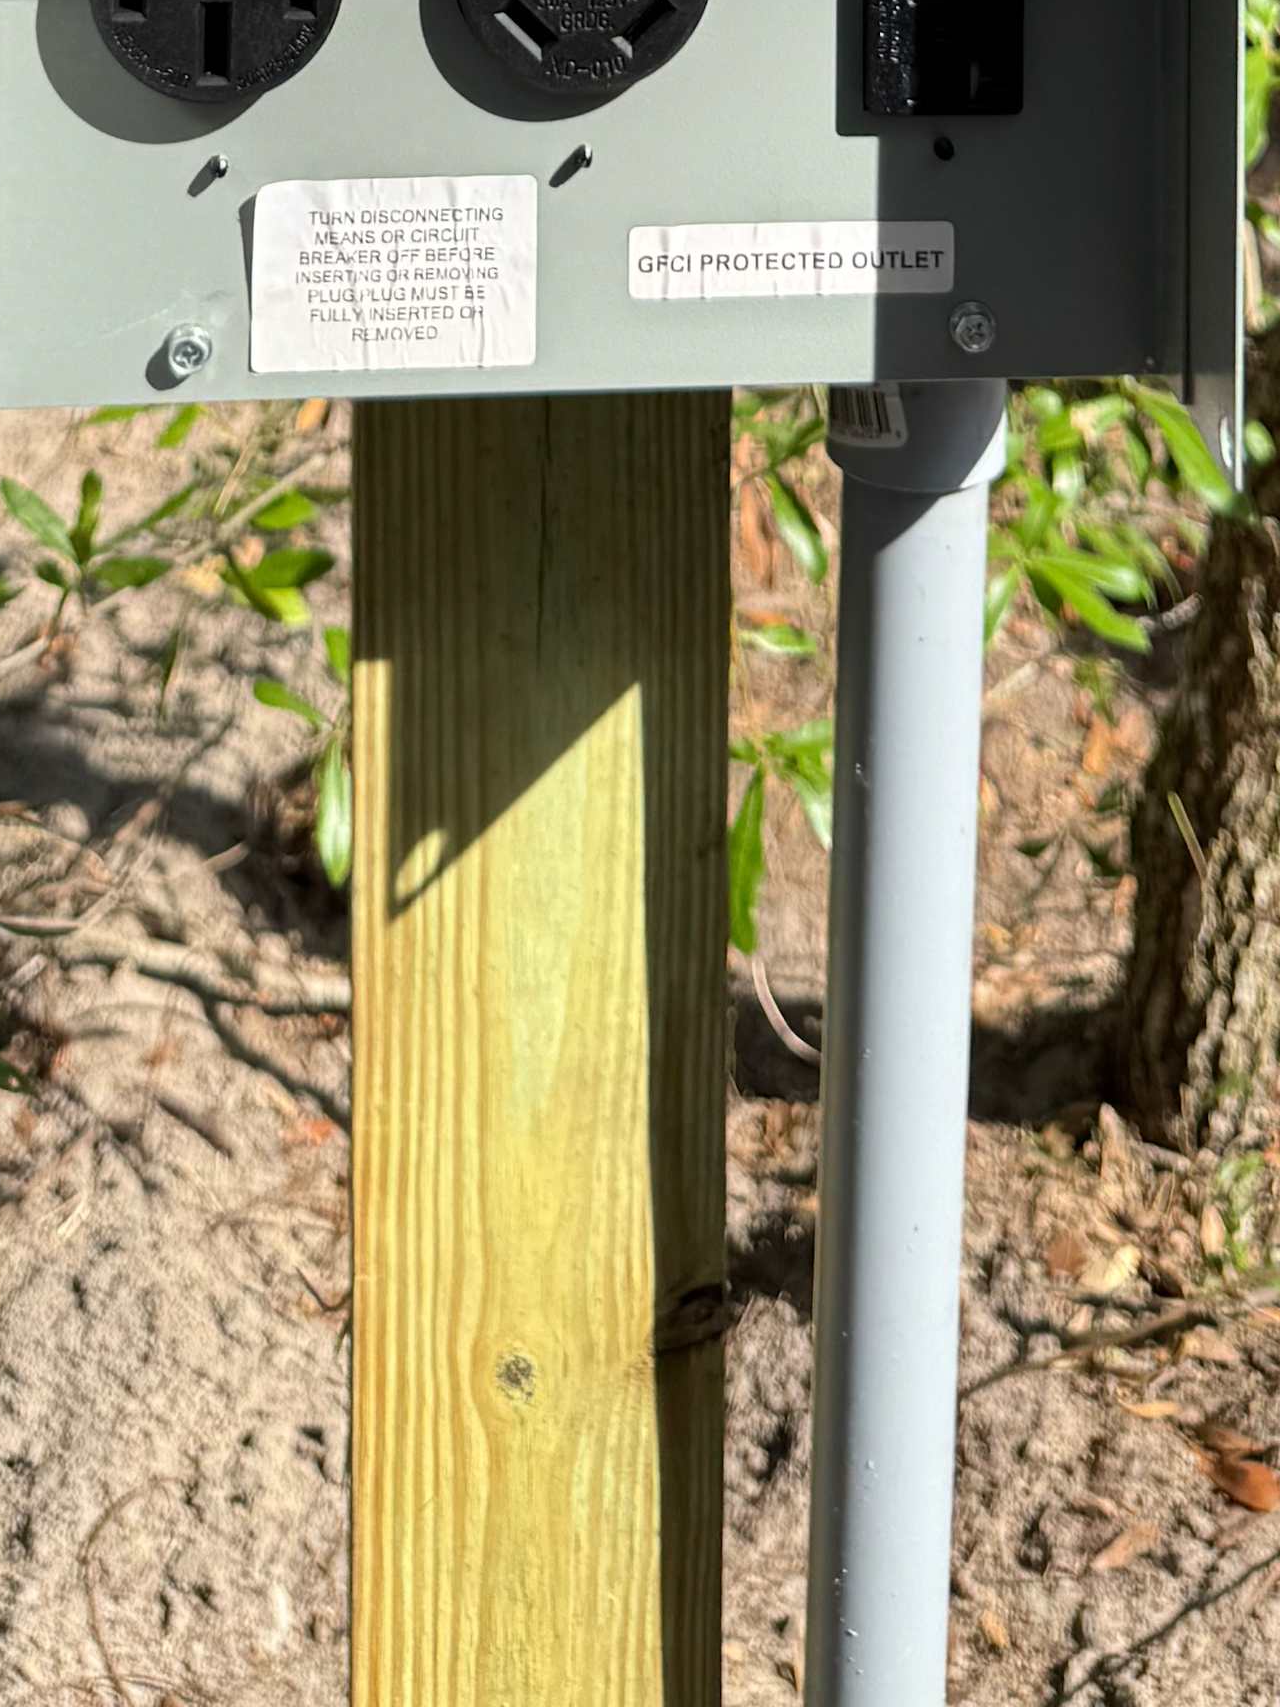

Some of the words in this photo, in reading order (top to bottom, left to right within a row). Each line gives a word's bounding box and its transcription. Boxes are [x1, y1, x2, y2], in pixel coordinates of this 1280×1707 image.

[309, 211, 355, 226] TURN
[360, 208, 504, 225] DISCONNECTING
[315, 230, 375, 246] MEANS
[381, 230, 404, 244] OR
[410, 228, 481, 242] CIRCUIT
[299, 251, 381, 265] BREAKER
[387, 249, 420, 263] OFF
[425, 247, 496, 263] BEFORE
[638, 255, 692, 273] GFCI
[700, 252, 844, 272] PROTECTED
[852, 250, 945, 270] OUTLET
[295, 270, 381, 284] INSERTING
[386, 269, 409, 282] OR
[413, 267, 499, 281] REMOVING
[308, 289, 355, 303] PLUG
[360, 288, 406, 302] PLUG
[411, 286, 459, 300] MUST
[464, 285, 486, 300] BE
[310, 308, 363, 323] FULLY
[369, 306, 454, 321] INSERTED
[352, 326, 438, 341] REMOVED
